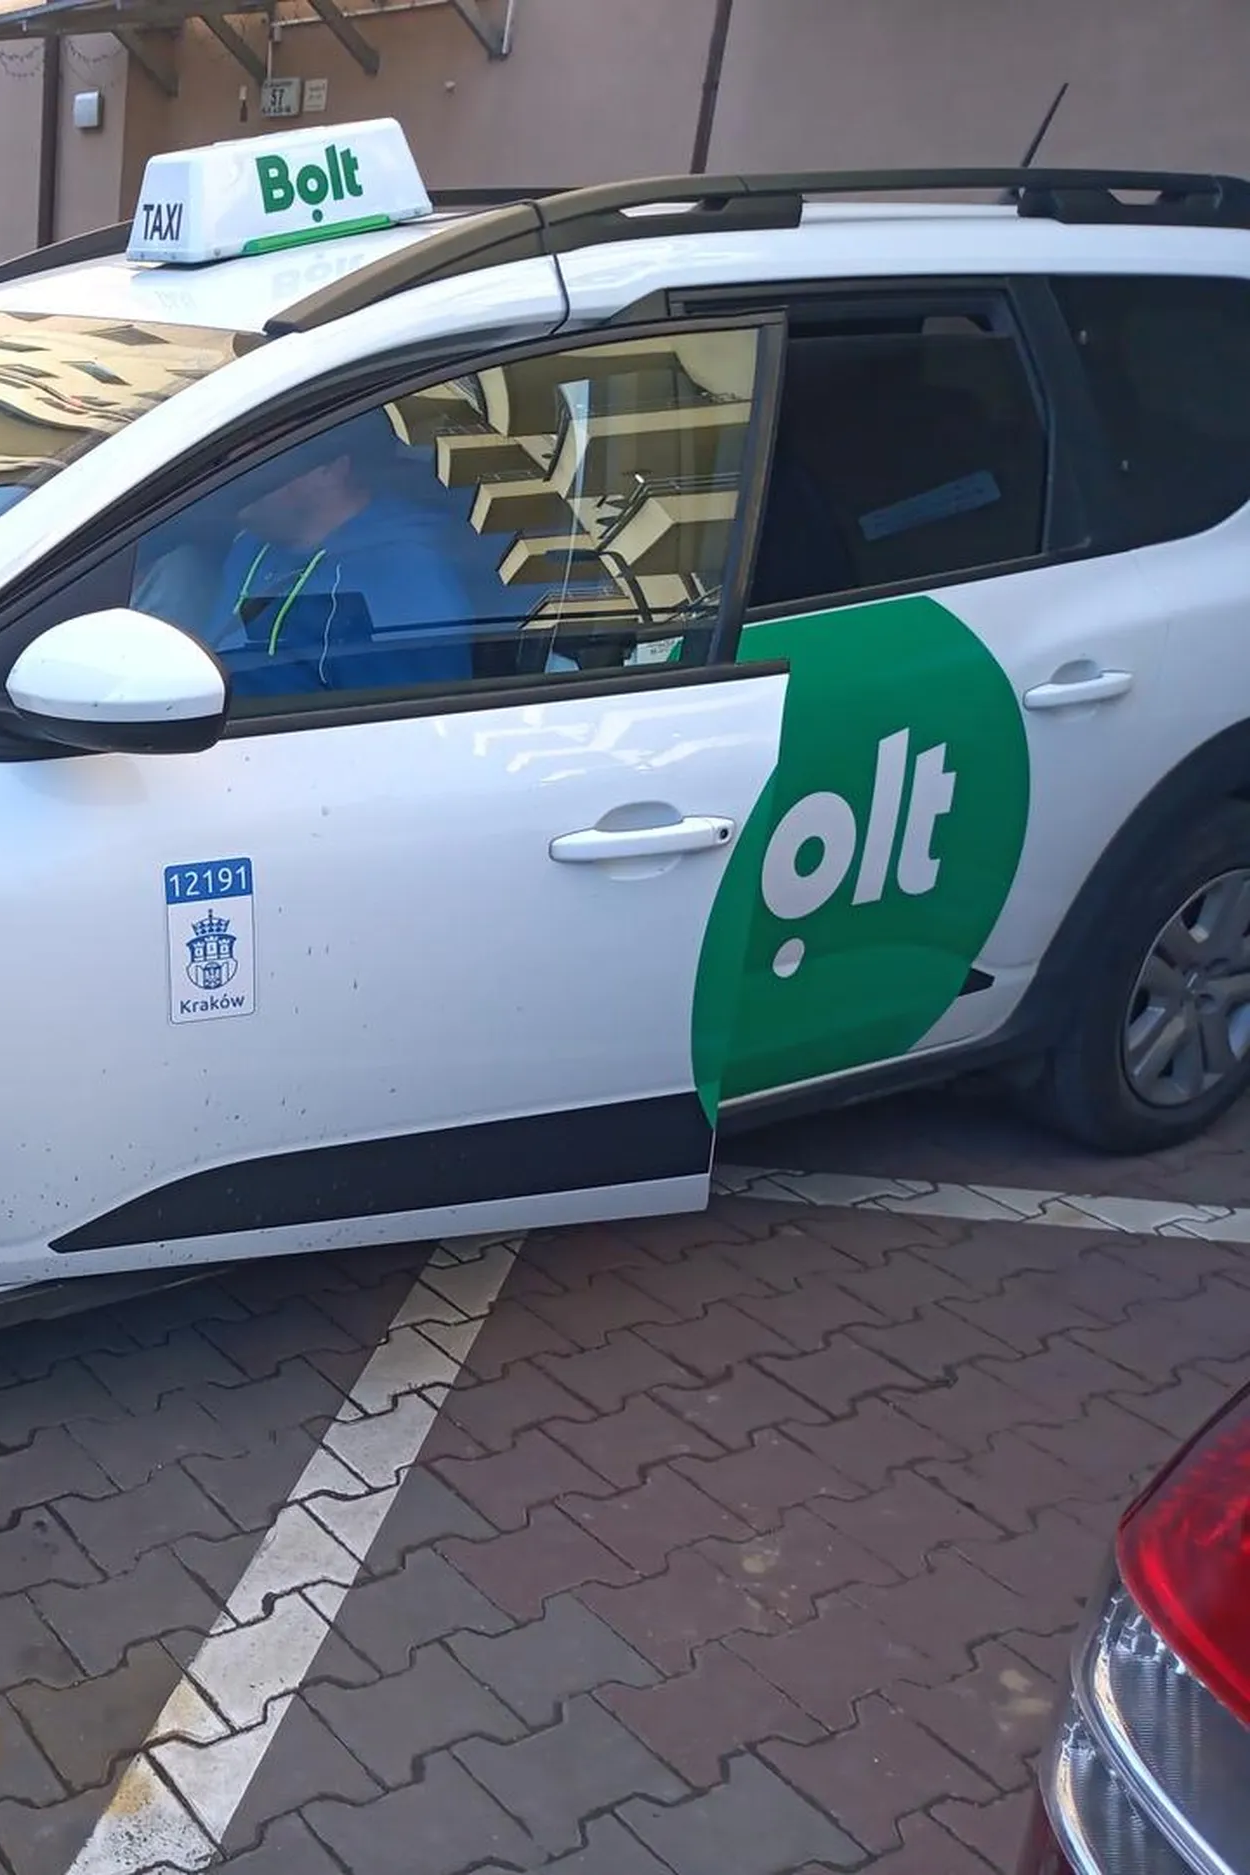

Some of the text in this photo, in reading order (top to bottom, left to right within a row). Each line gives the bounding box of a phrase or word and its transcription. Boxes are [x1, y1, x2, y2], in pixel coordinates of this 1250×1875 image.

[255, 144, 364, 223] Bolt
[142, 202, 183, 241] TAXI
[761, 727, 957, 978] olt
[169, 865, 248, 898] 12191
[179, 994, 246, 1015] Kraków
